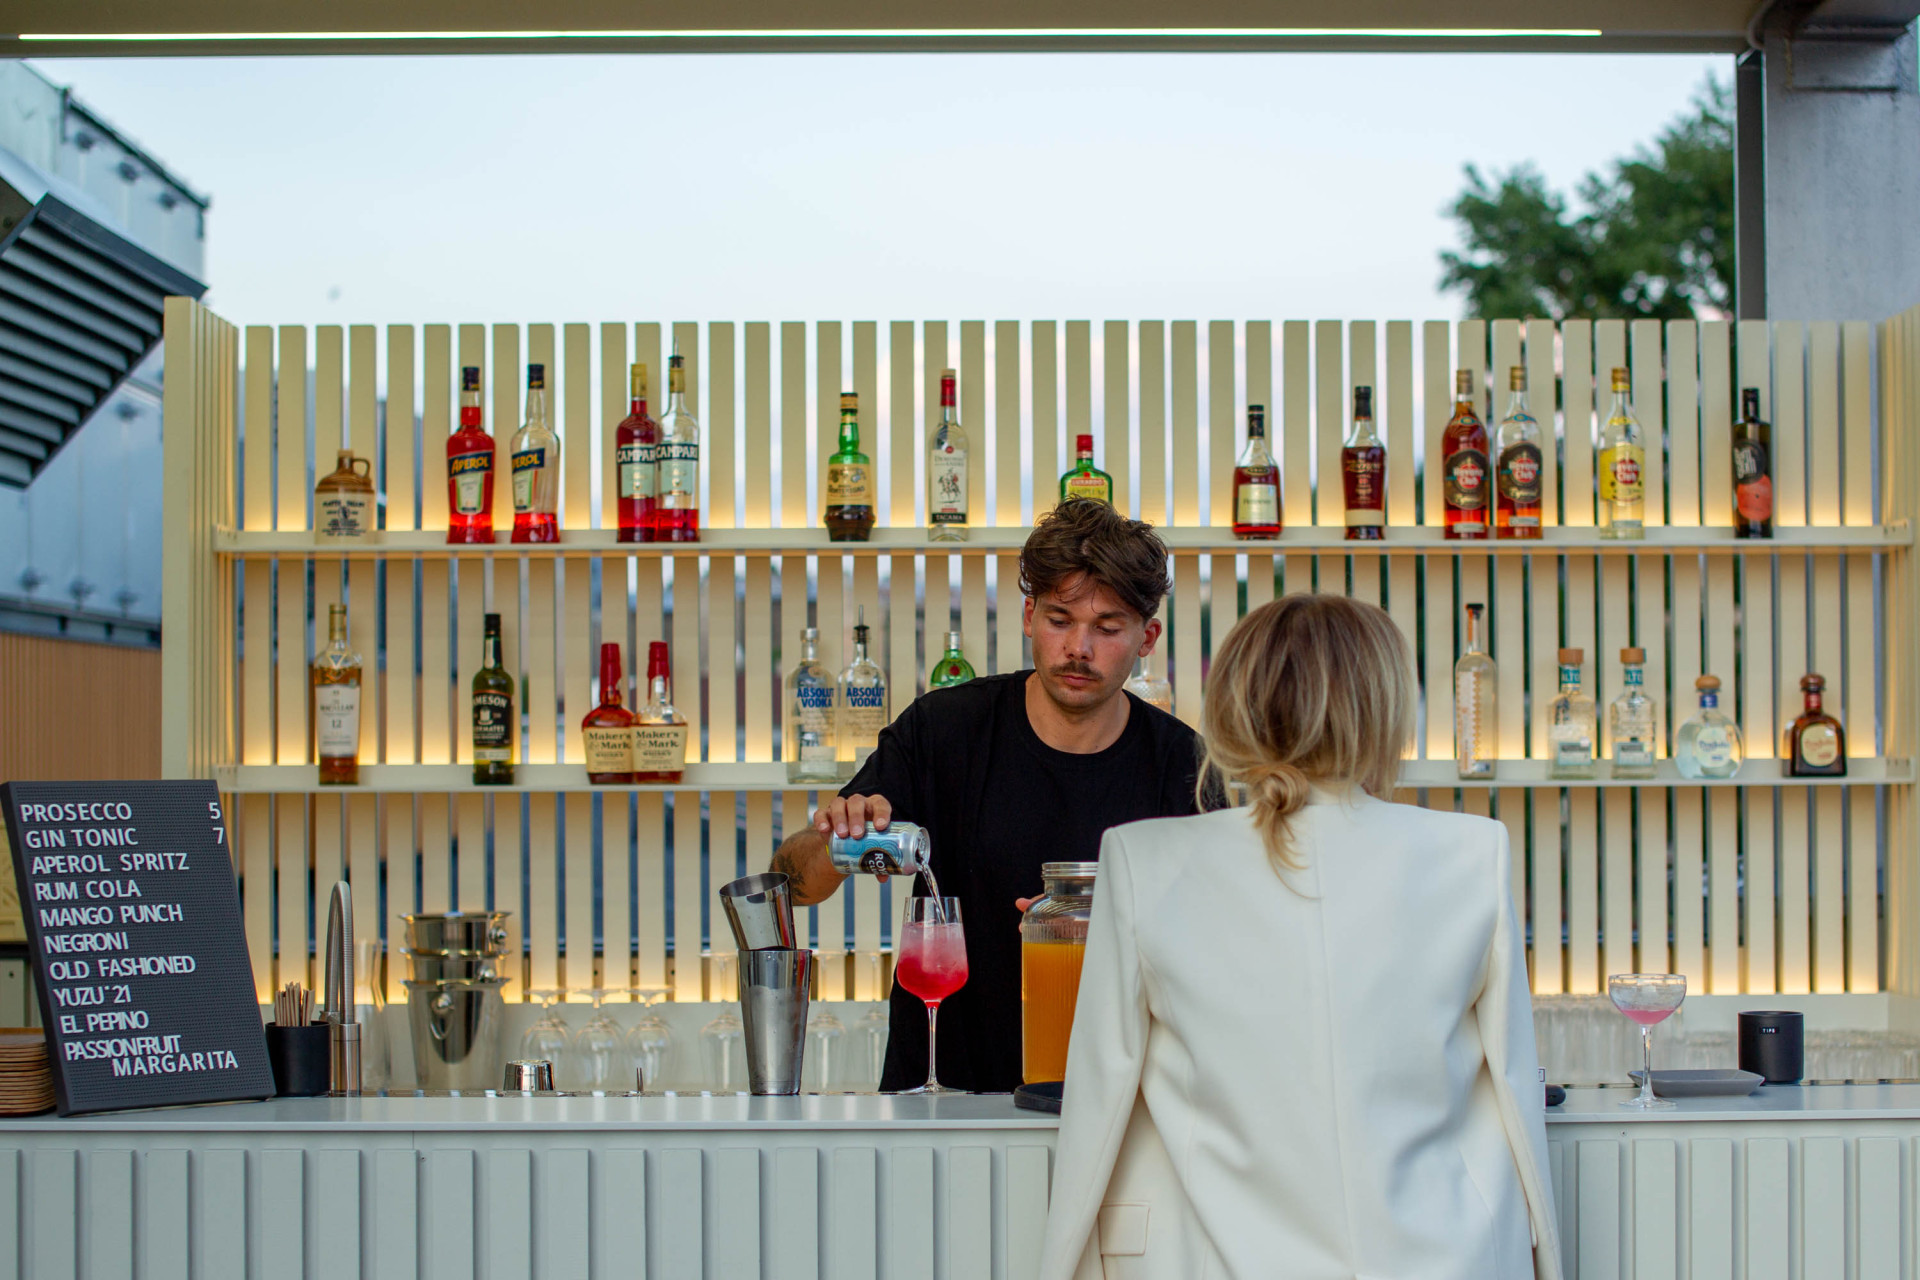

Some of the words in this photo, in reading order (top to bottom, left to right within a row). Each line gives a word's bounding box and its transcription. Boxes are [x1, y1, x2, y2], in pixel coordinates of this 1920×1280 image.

[617, 449, 656, 462] CAMPAR
[656, 446, 698, 458] CAMPARI
[452, 457, 489, 474] APEROL
[796, 688, 834, 698] ABSOLUT
[846, 687, 885, 697] ABSOLUT
[850, 697, 883, 707] VODKA
[801, 698, 833, 708] VODKA
[589, 732, 631, 740] Maker's
[636, 731, 679, 739] Maker's
[20, 803, 133, 822] PROSECCO
[209, 802, 221, 819] 5
[25, 830, 66, 849] GIN
[71, 827, 138, 847] TONIC
[212, 827, 224, 844] 7
[31, 854, 111, 875] APEROL
[119, 853, 190, 871] SPRITZ
[875, 853, 889, 875] ROY
[35, 881, 78, 901] RUM
[86, 880, 142, 898] COLA
[40, 906, 113, 927] MANGO
[120, 904, 184, 923] PUNCH
[44, 932, 129, 953] NEGRONI
[50, 960, 90, 981] OLD
[98, 955, 196, 977] FASHIONED
[60, 1014, 84, 1034] EL
[87, 1011, 149, 1032] PEPINO
[64, 1034, 181, 1061] PASSIONFRUIT
[112, 1051, 239, 1077] MARGARITA
